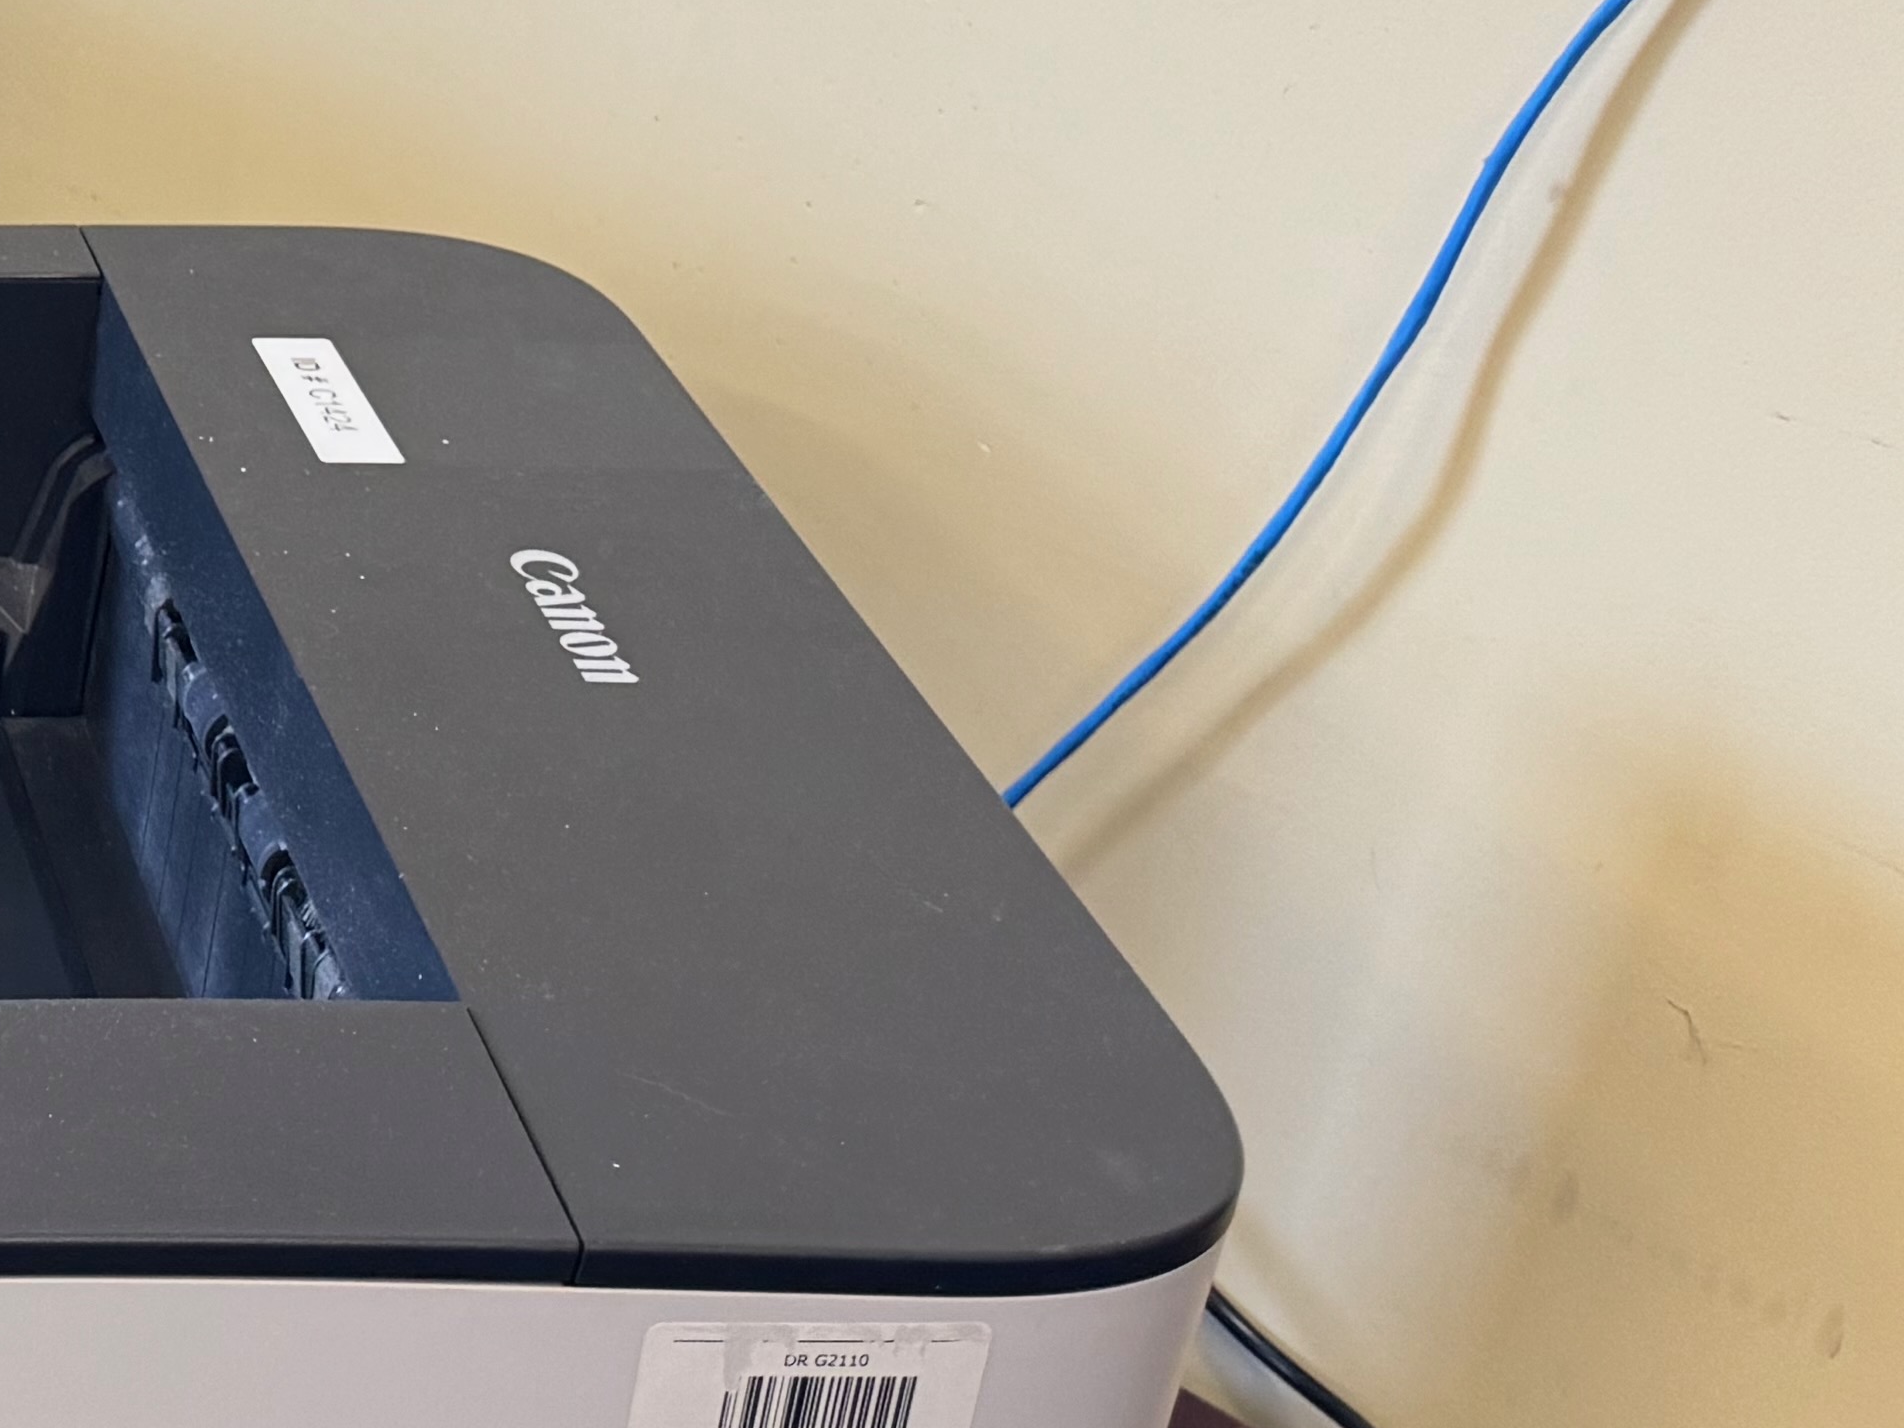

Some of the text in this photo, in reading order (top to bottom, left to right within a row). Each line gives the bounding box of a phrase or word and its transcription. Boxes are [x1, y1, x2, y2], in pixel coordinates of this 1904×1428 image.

[509, 548, 639, 684] Canon
[783, 1354, 870, 1367] DR G2110
